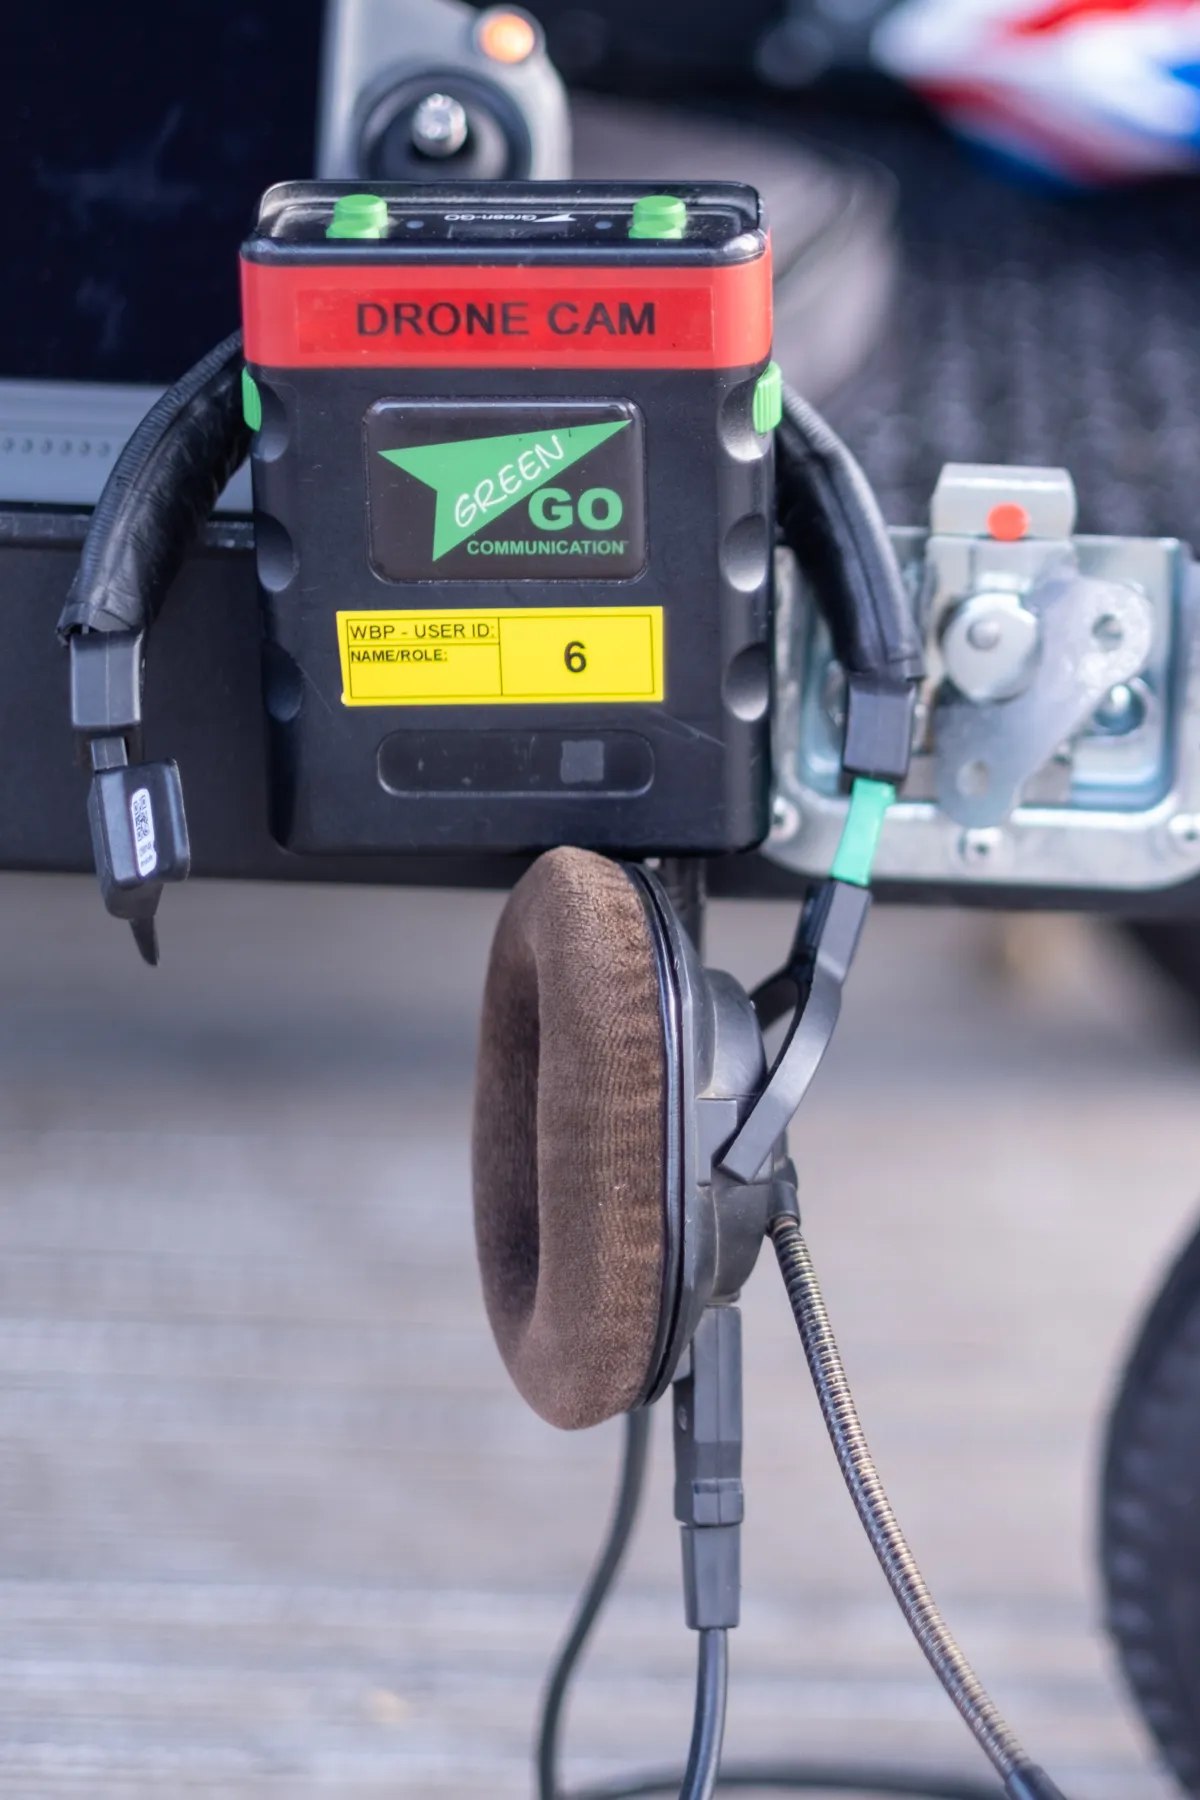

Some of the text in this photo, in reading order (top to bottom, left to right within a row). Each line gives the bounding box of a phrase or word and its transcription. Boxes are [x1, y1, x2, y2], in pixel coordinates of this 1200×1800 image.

[444, 213, 537, 222] Green-GO
[357, 301, 656, 336] DRONE CAM
[454, 435, 565, 528] GREEN
[528, 487, 624, 531] GO
[467, 539, 625, 556] COMMUNICATION
[350, 624, 396, 640] WBP
[414, 623, 466, 639] USER
[472, 623, 496, 638] ID:
[350, 648, 448, 663] NAME/ROLE:
[563, 641, 588, 673] 6
